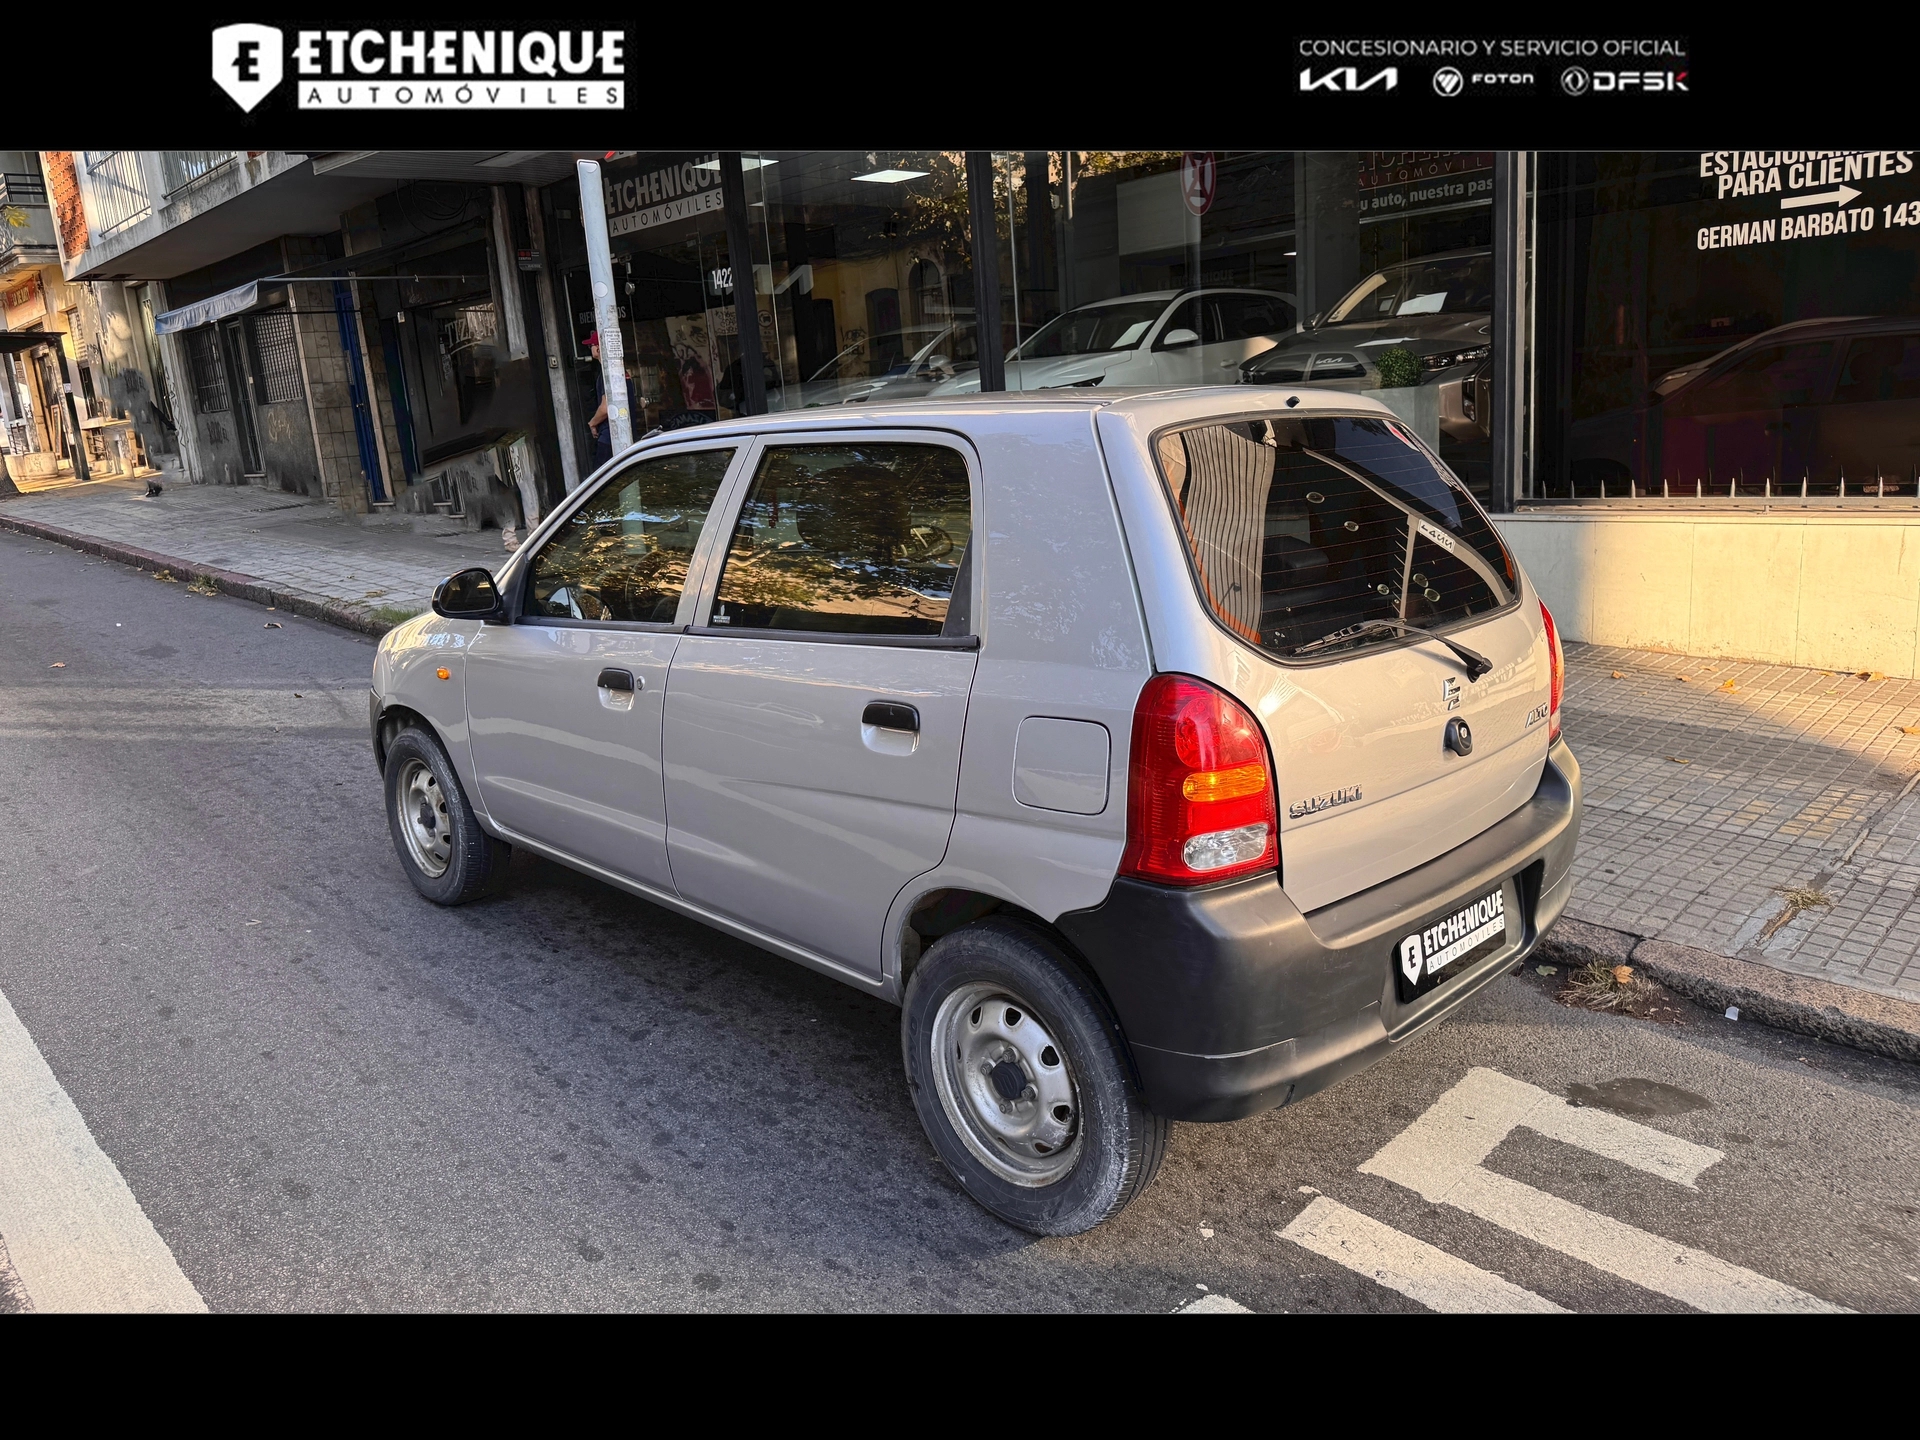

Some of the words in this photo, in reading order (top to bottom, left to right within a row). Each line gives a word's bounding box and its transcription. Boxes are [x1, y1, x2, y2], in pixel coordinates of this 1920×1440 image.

[604, 152, 722, 214] ETCHENIQUE
[1371, 194, 1407, 208] auto,
[1410, 184, 1465, 203] nuestra
[1718, 167, 1782, 200] PARA
[1788, 151, 1914, 190] CLIENTES
[612, 192, 722, 234] AUTOMÓVILES
[1697, 219, 1776, 250] GERMAN
[1780, 207, 1875, 241] BARBATO
[711, 267, 734, 290] 1422
[1525, 702, 1549, 728] ALTO
[1289, 784, 1363, 819] SUZUKI
[1423, 889, 1504, 956] ETCHENIQUE
